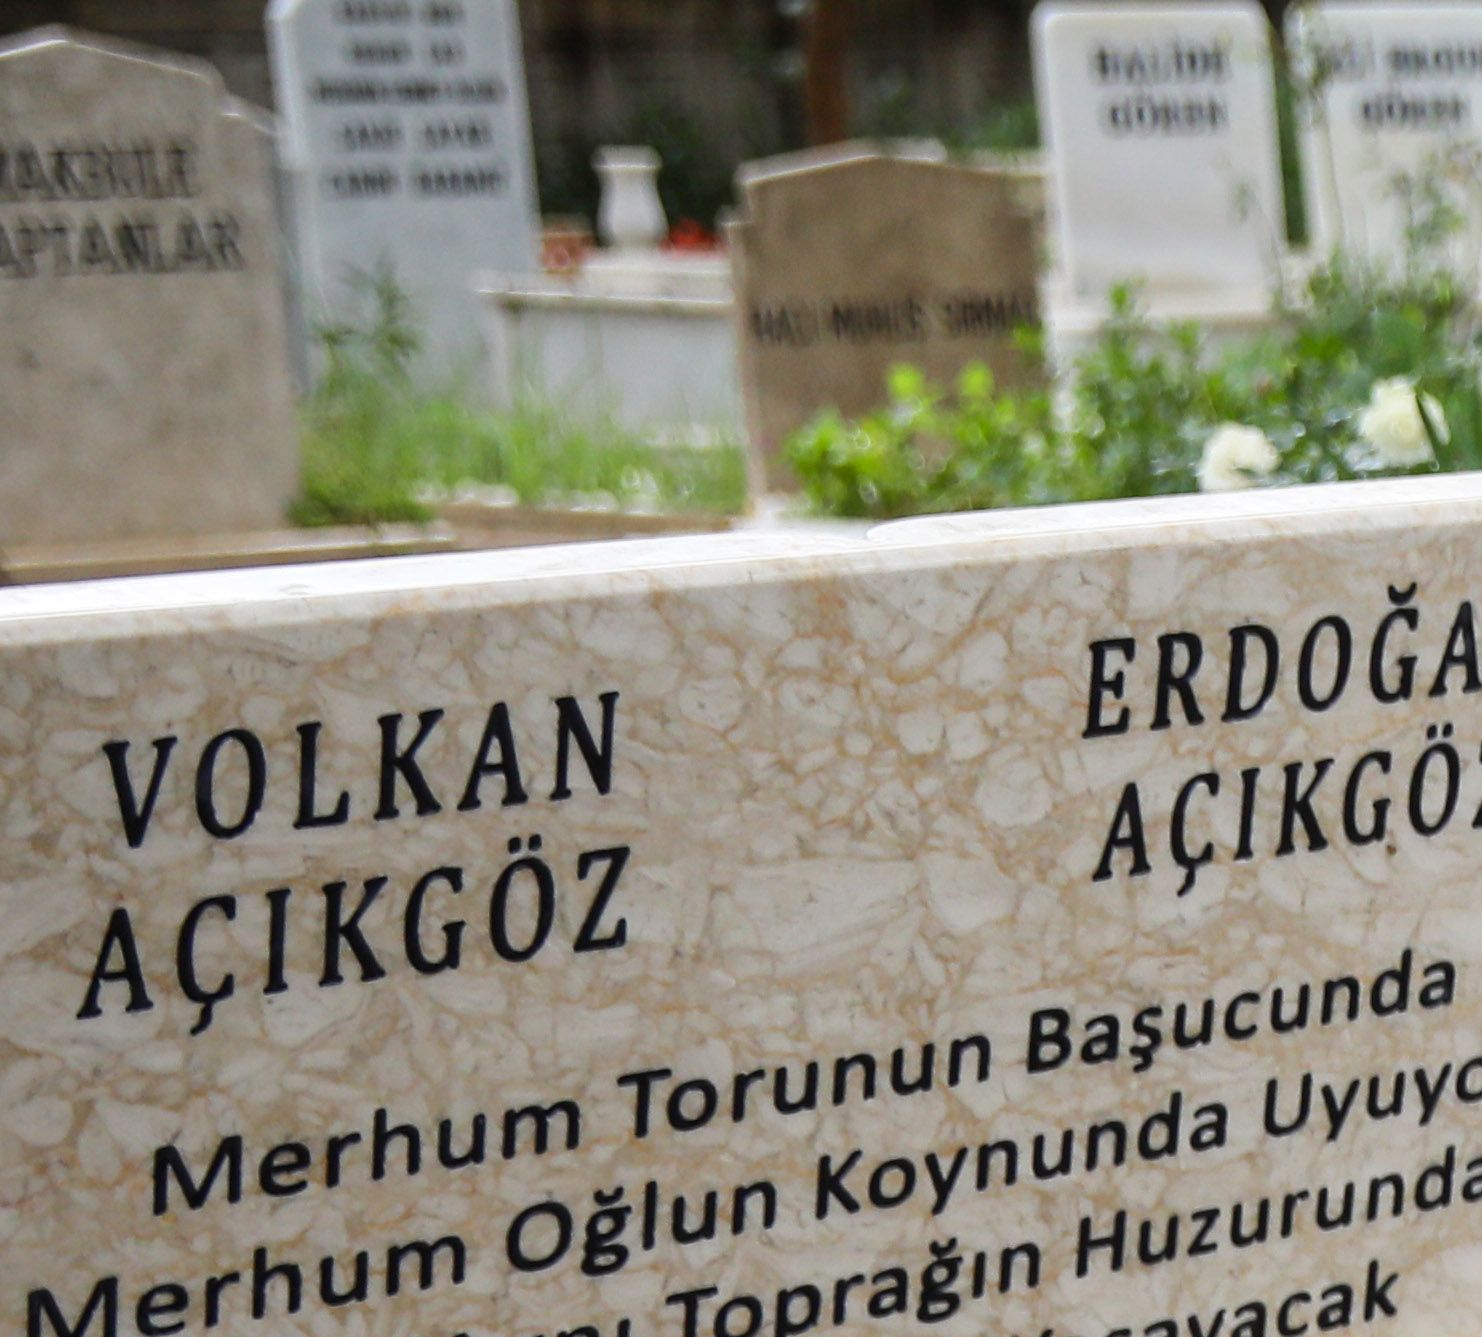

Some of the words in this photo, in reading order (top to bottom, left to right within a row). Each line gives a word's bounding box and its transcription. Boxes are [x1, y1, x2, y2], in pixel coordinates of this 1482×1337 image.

[99, 689, 621, 850] VOLKAN
[74, 832, 632, 1039] AÇIKGÖZ
[149, 1098, 583, 1218] Merhum
[615, 1033, 992, 1140] Torunun
[1024, 947, 1457, 1075] Başucunda
[504, 1179, 778, 1279] Oğlun
[814, 1090, 1229, 1222] Koynunda
